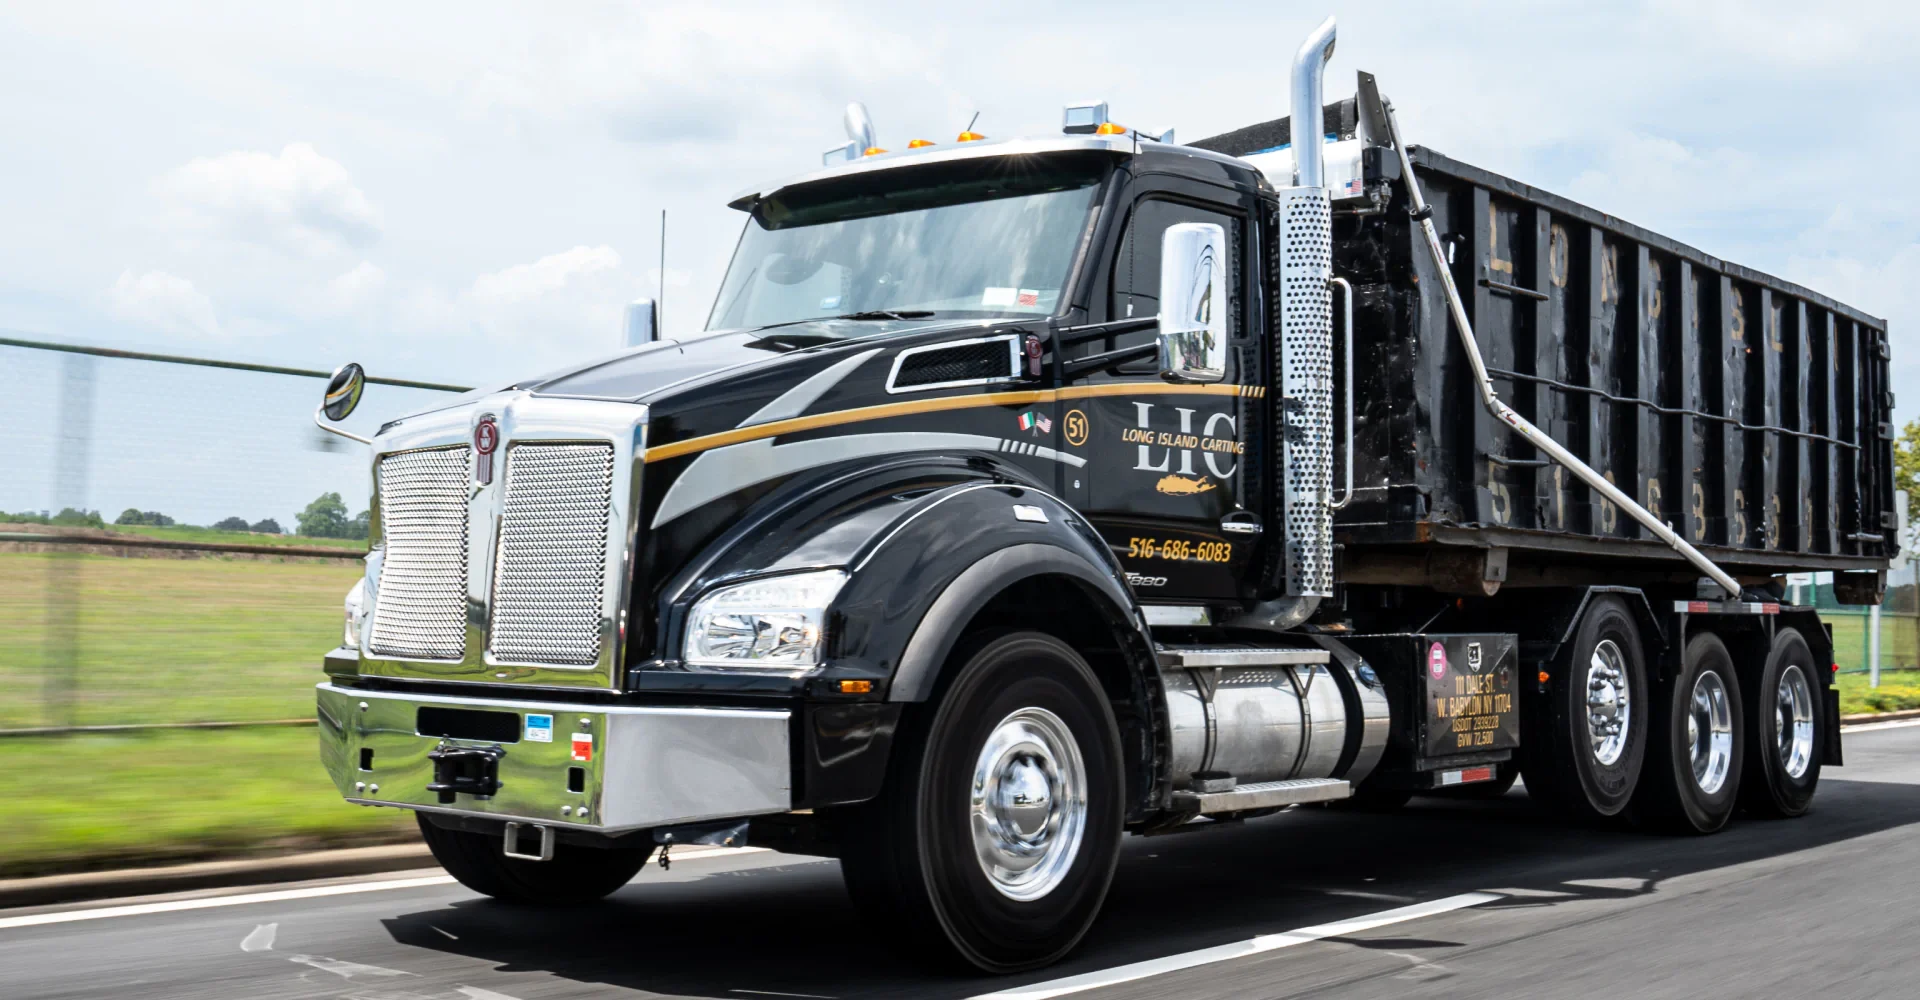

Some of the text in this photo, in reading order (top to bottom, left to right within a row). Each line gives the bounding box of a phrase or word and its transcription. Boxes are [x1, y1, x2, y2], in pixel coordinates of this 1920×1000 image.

[1068, 417, 1085, 438] 51
[1122, 428, 1245, 454] LONG ISLAND CARTING
[1131, 401, 1238, 480] LIC
[1127, 537, 1232, 562] 516-686-6083
[1455, 673, 1496, 695] 111 DALE ST.
[1437, 693, 1512, 718] W. BABYLON NY 11704
[1452, 717, 1472, 732] USDOT
[1457, 732, 1472, 747] GVW
